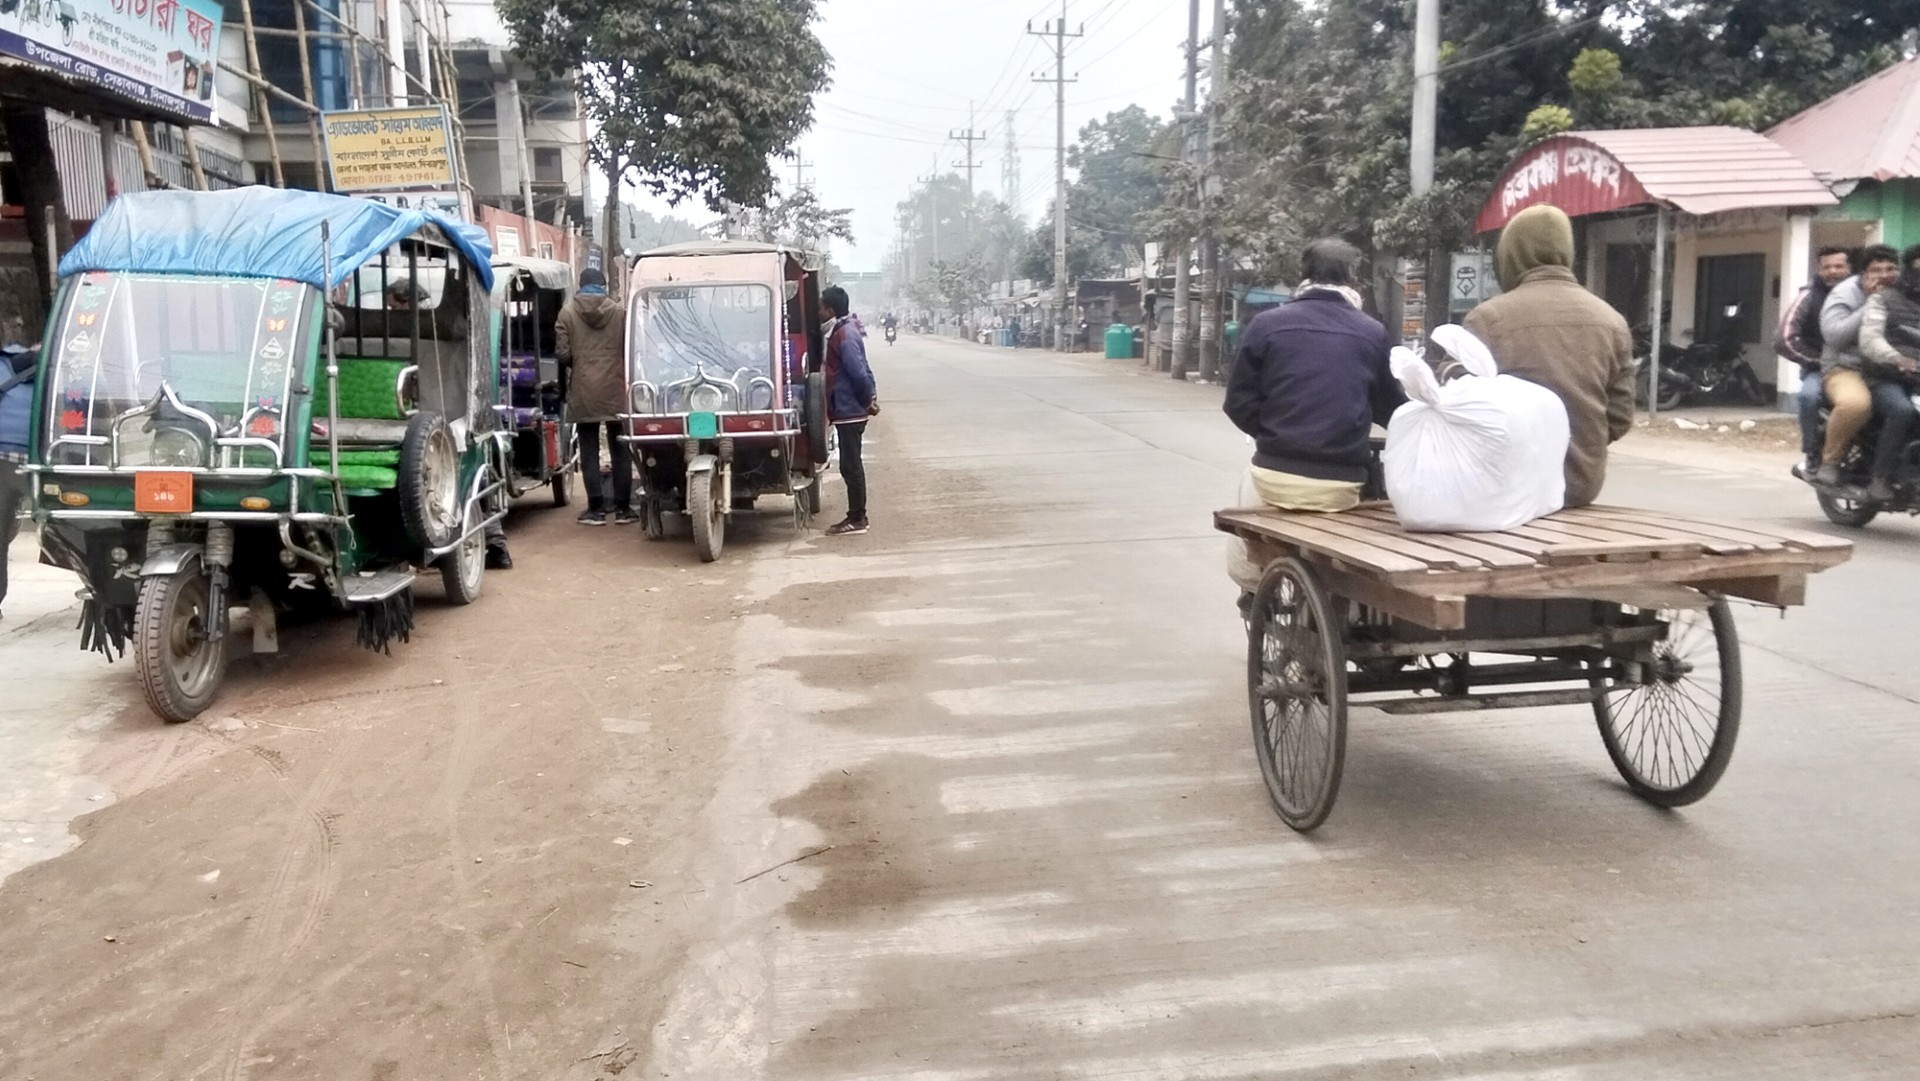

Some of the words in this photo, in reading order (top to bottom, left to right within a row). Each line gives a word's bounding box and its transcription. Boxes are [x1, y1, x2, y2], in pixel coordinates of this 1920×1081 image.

[185, 8, 214, 51] ঘর
[25, 39, 72, 69] উপজেলা
[74, 61, 100, 84] রোড,
[335, 150, 378, 161] বাংলাদেশ
[406, 145, 428, 157] কোর্ট
